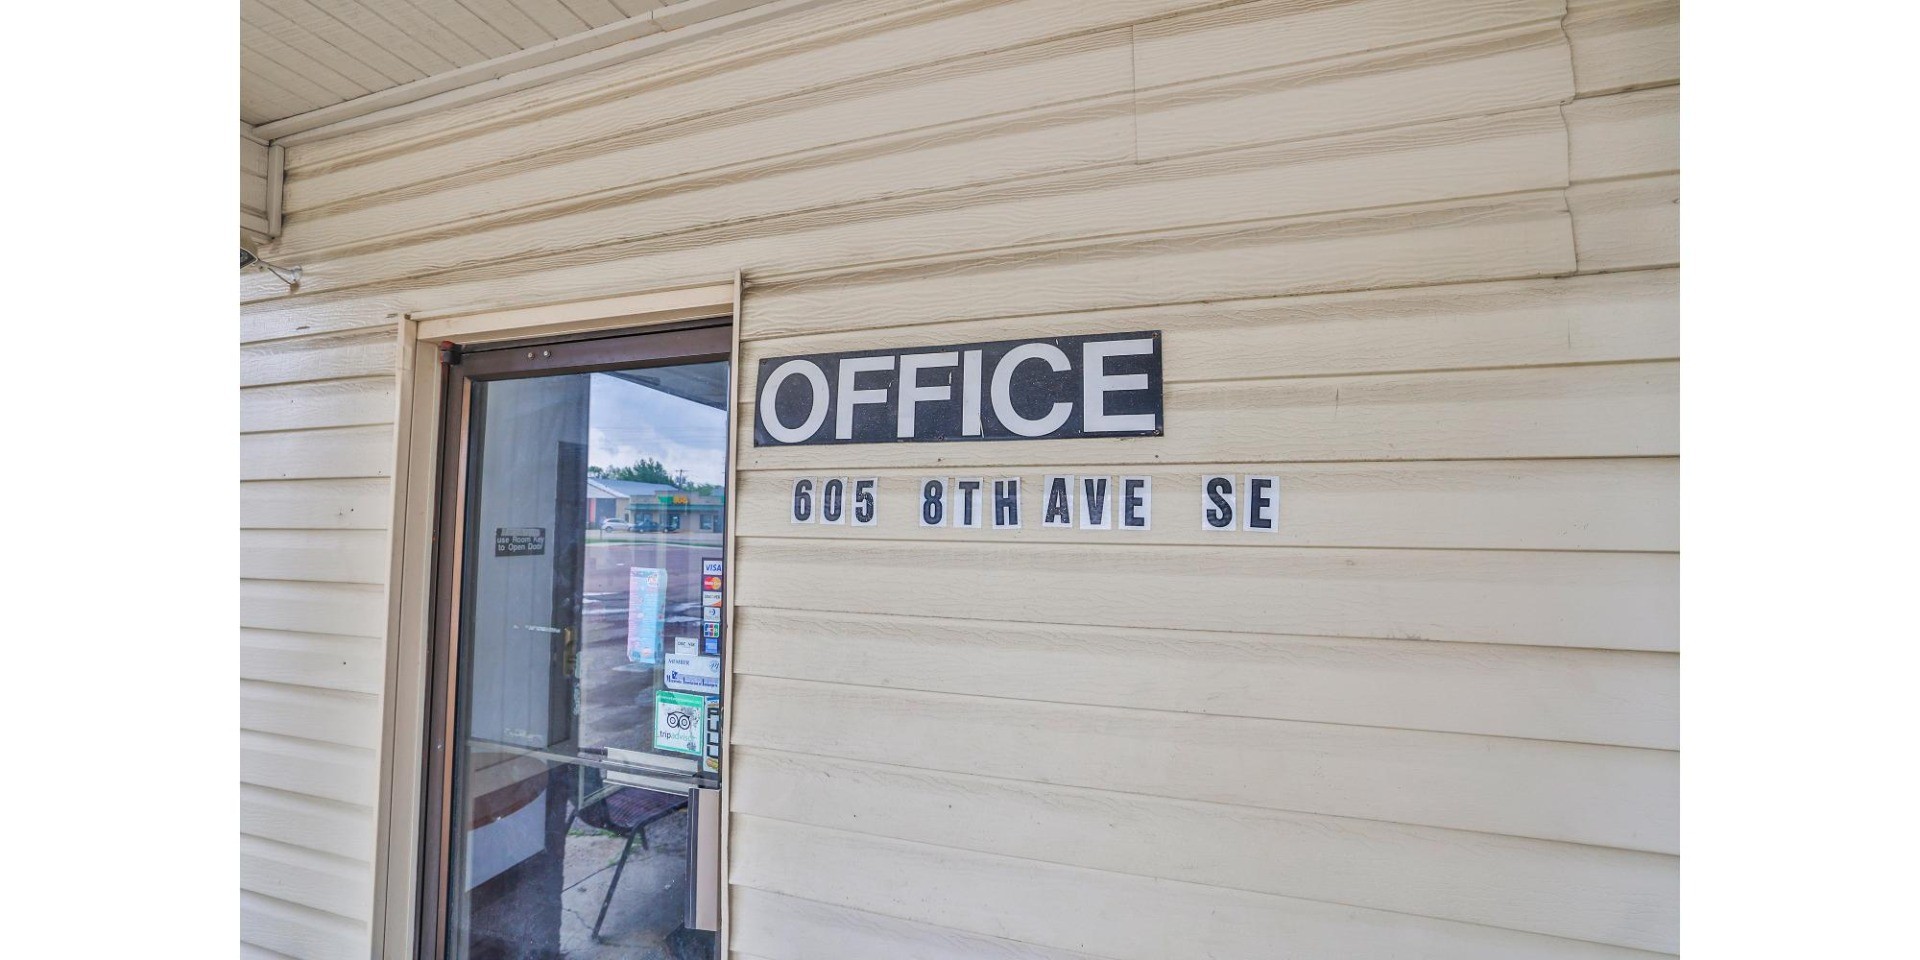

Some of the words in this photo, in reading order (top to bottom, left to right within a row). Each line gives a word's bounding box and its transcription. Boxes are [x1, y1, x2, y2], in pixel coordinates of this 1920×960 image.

[759, 338, 1157, 444] OFFICE
[793, 478, 875, 523] 605
[923, 479, 1019, 526] 8TH
[1044, 477, 1145, 526] AVE
[1206, 477, 1272, 529] SE
[508, 543, 525, 552] Open
